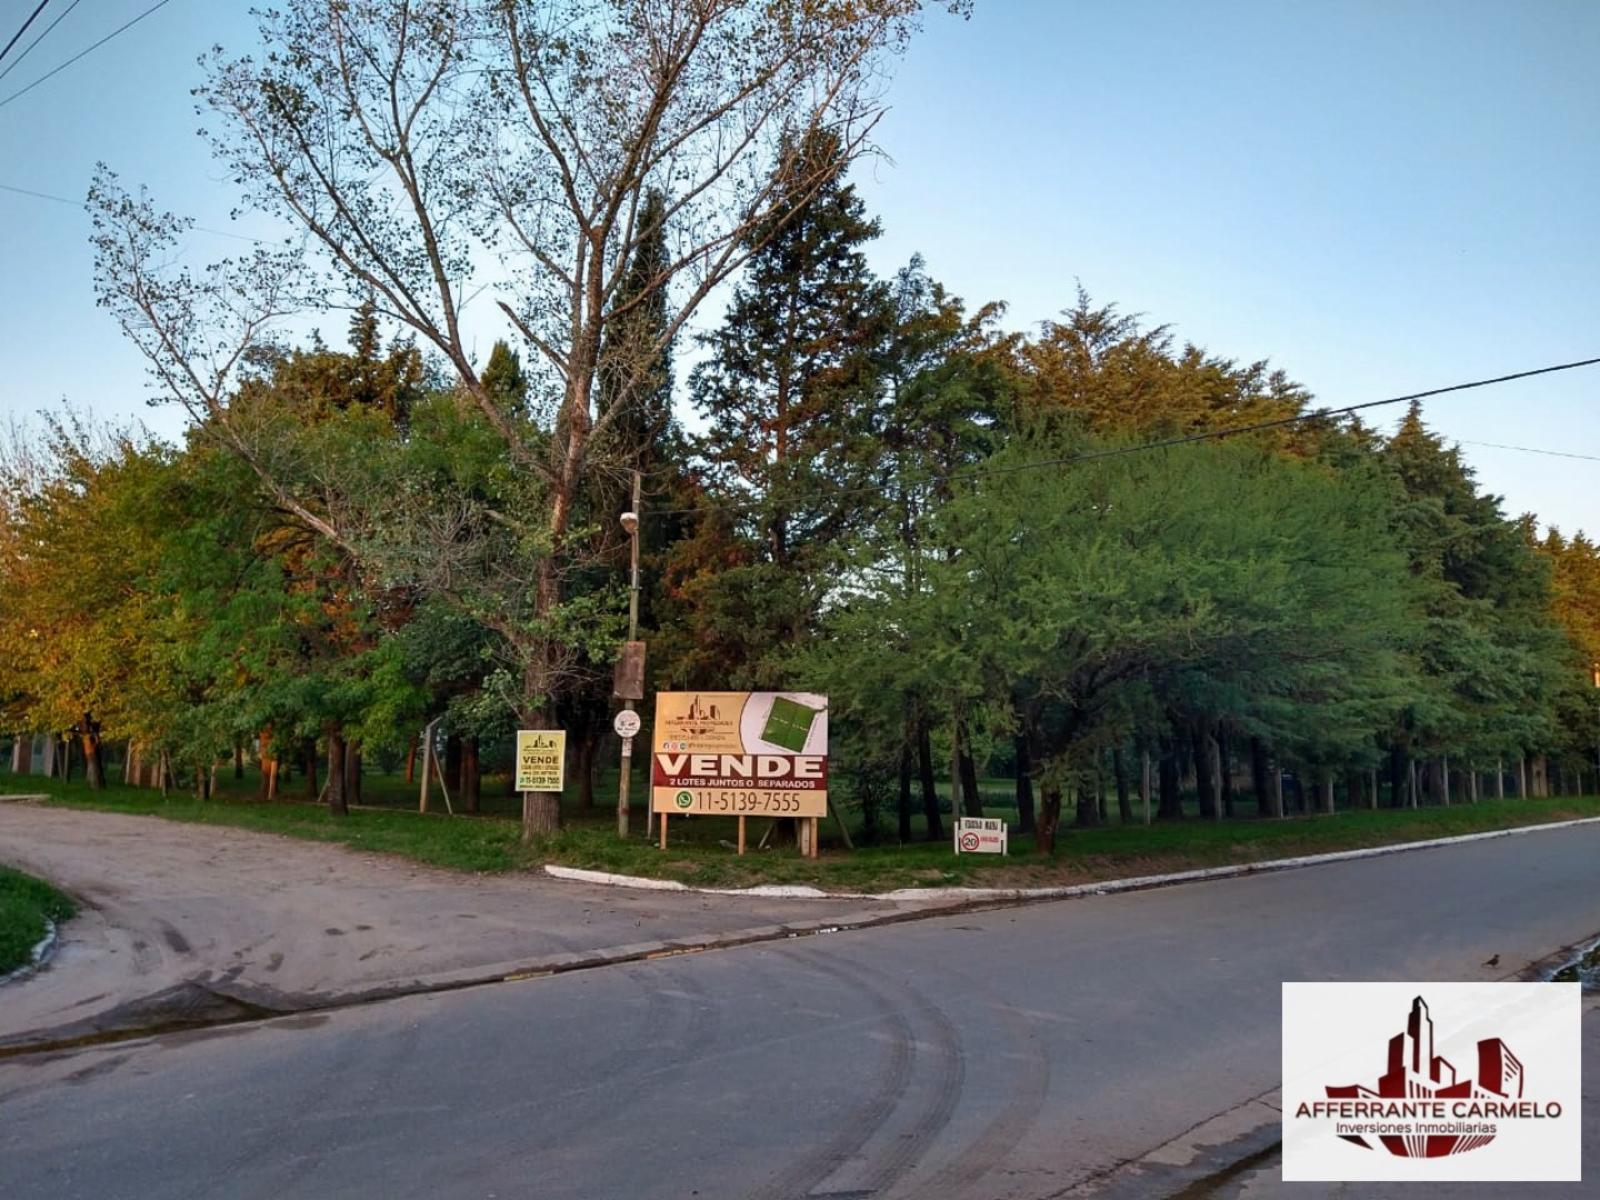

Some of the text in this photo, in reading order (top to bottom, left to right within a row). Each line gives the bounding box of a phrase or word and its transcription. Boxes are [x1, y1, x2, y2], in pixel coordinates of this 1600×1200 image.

[523, 756, 559, 764] VENDE
[656, 754, 824, 778] VENDE
[707, 779, 745, 787] JUNTOS
[758, 779, 816, 789] SEPARADOS
[697, 791, 801, 812] 11-5139-7555
[964, 837, 977, 847] 20
